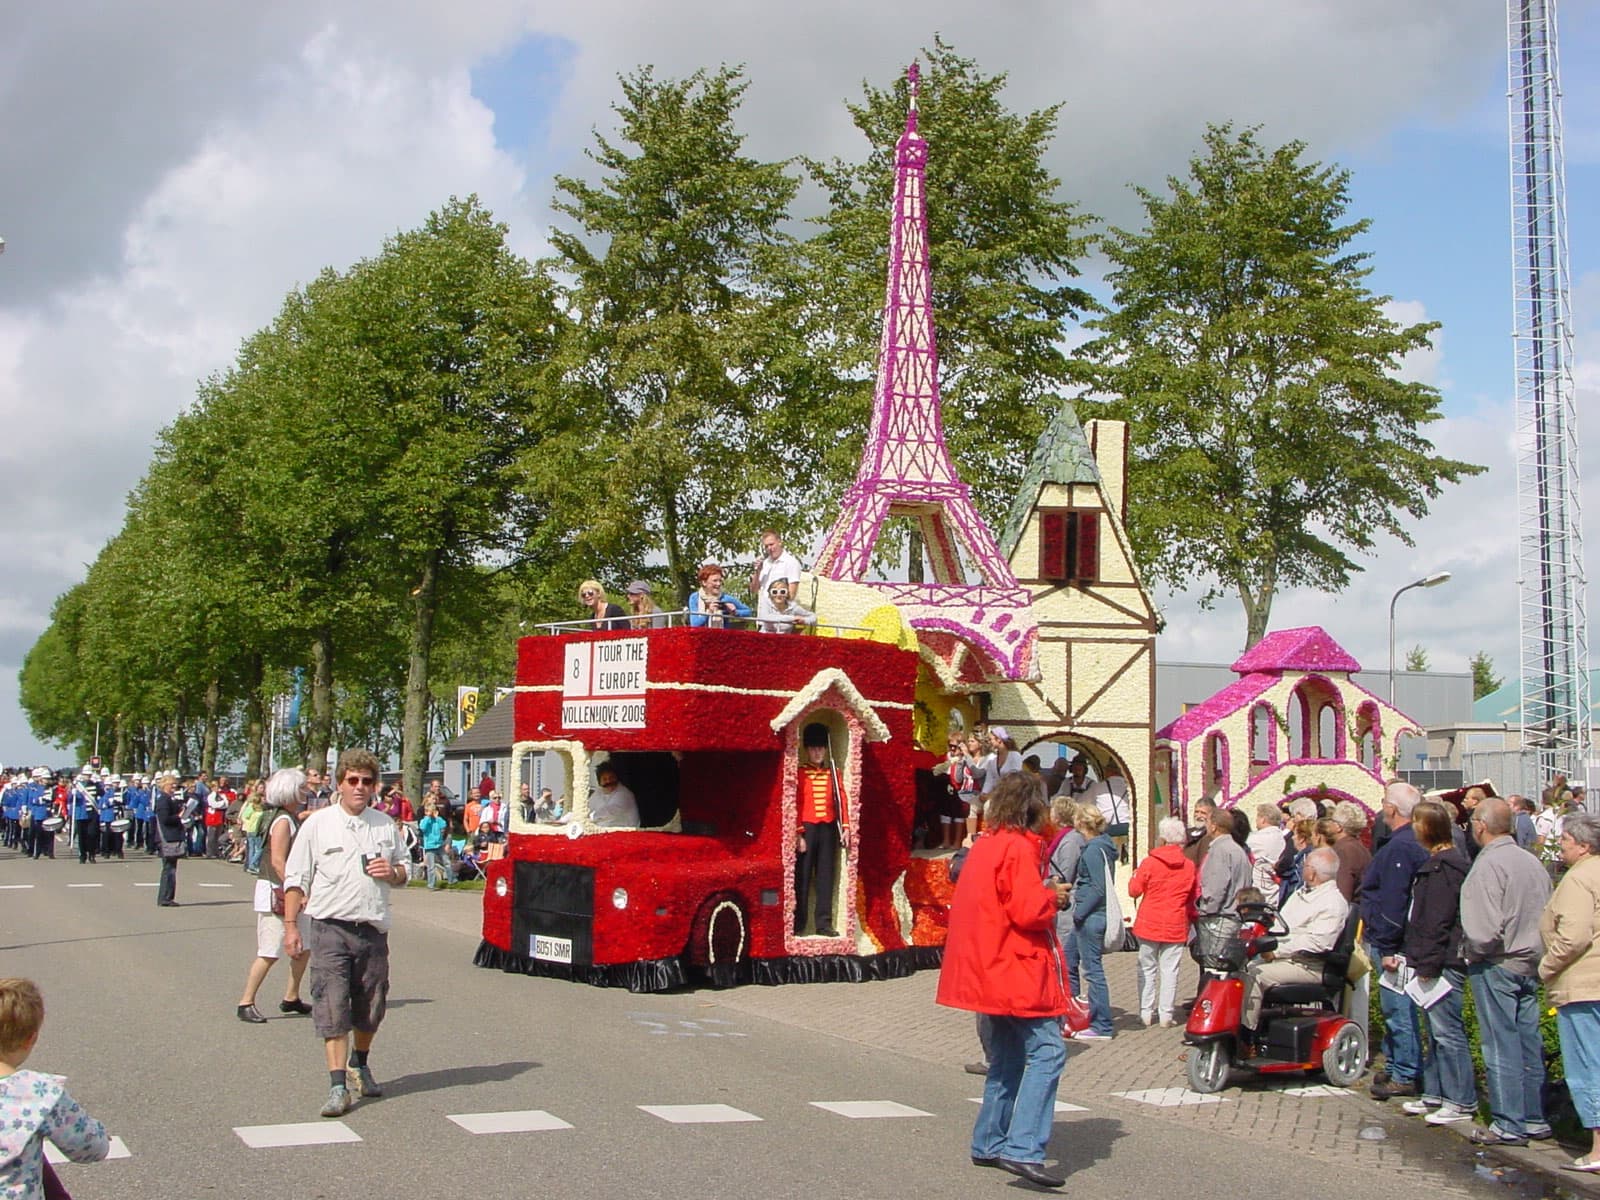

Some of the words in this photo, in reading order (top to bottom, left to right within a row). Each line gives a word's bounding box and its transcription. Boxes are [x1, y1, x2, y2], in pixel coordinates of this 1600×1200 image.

[598, 645, 622, 663] TOUR
[626, 643, 644, 661] THE
[573, 658, 580, 679] 8
[600, 671, 640, 690] EUROPE
[622, 704, 646, 722] 2009
[554, 942, 571, 959] SMR
